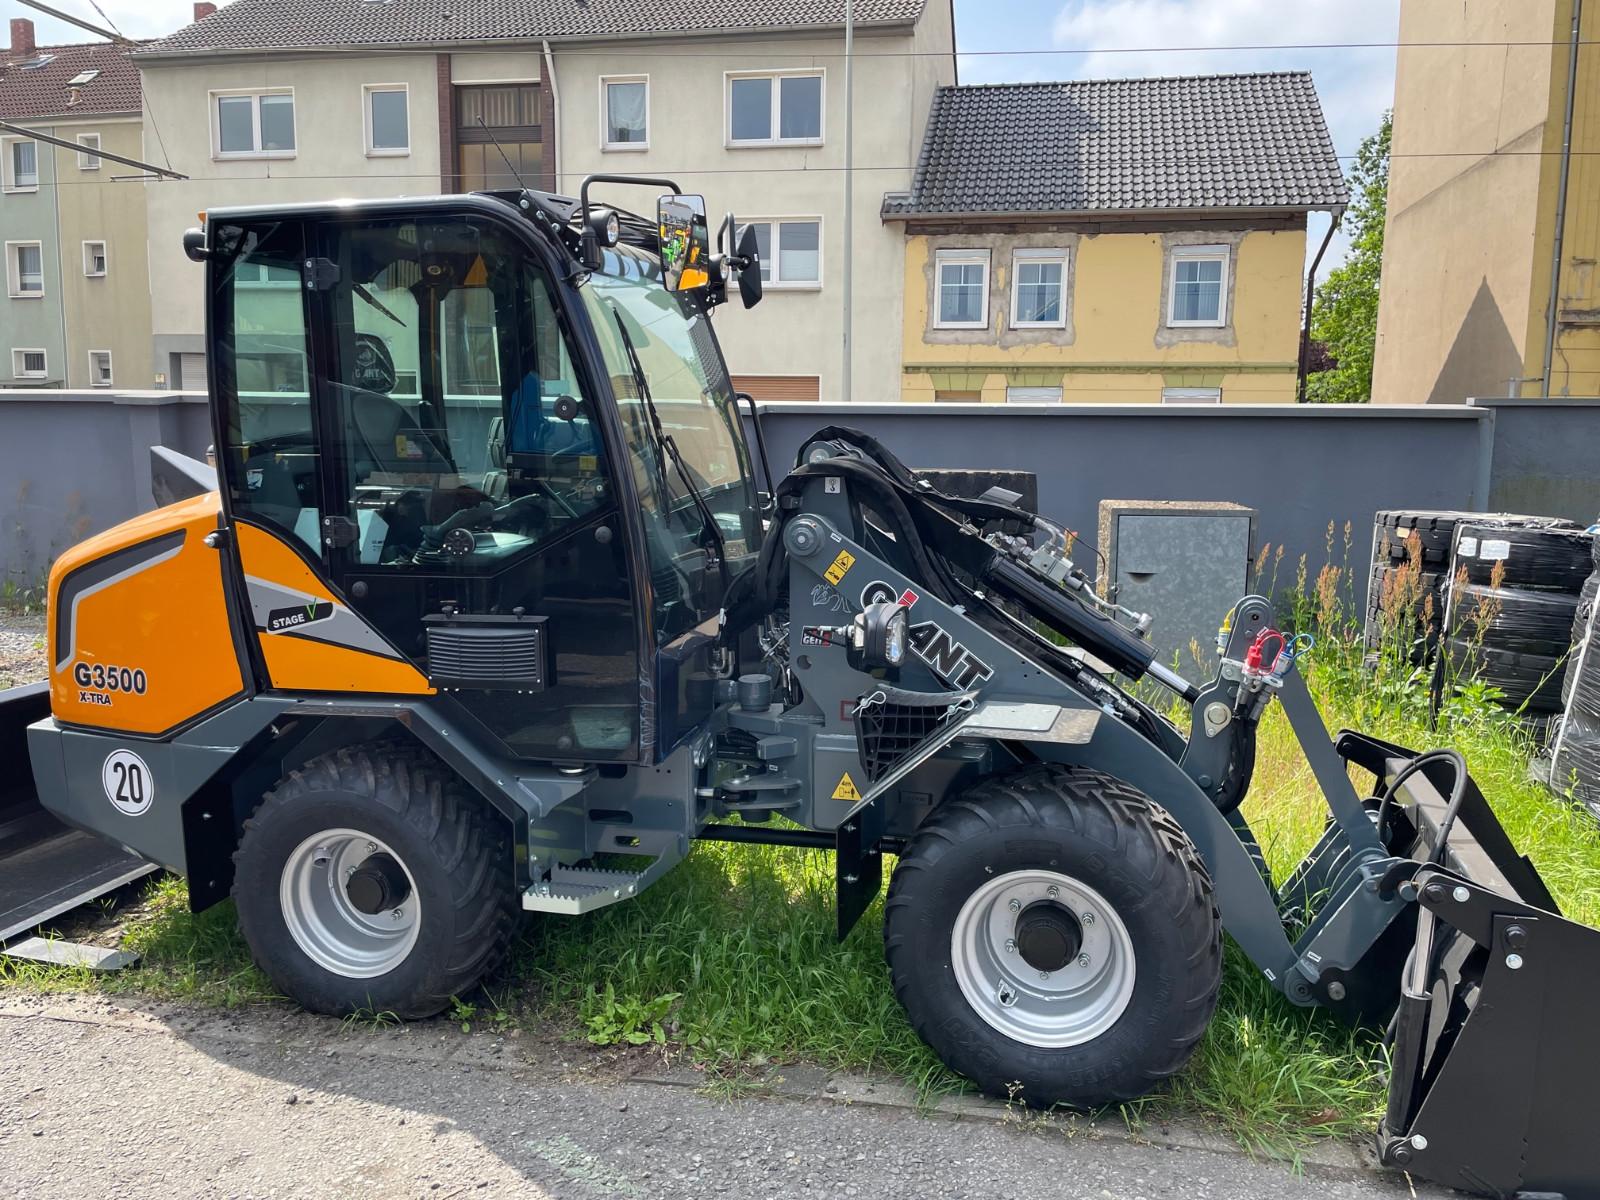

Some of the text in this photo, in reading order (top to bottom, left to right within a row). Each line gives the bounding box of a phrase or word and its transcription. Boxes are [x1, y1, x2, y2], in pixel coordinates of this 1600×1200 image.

[272, 613, 305, 629] STAGE
[74, 661, 148, 696] G3500
[79, 691, 113, 706] X-TRA
[113, 761, 144, 804] 20
